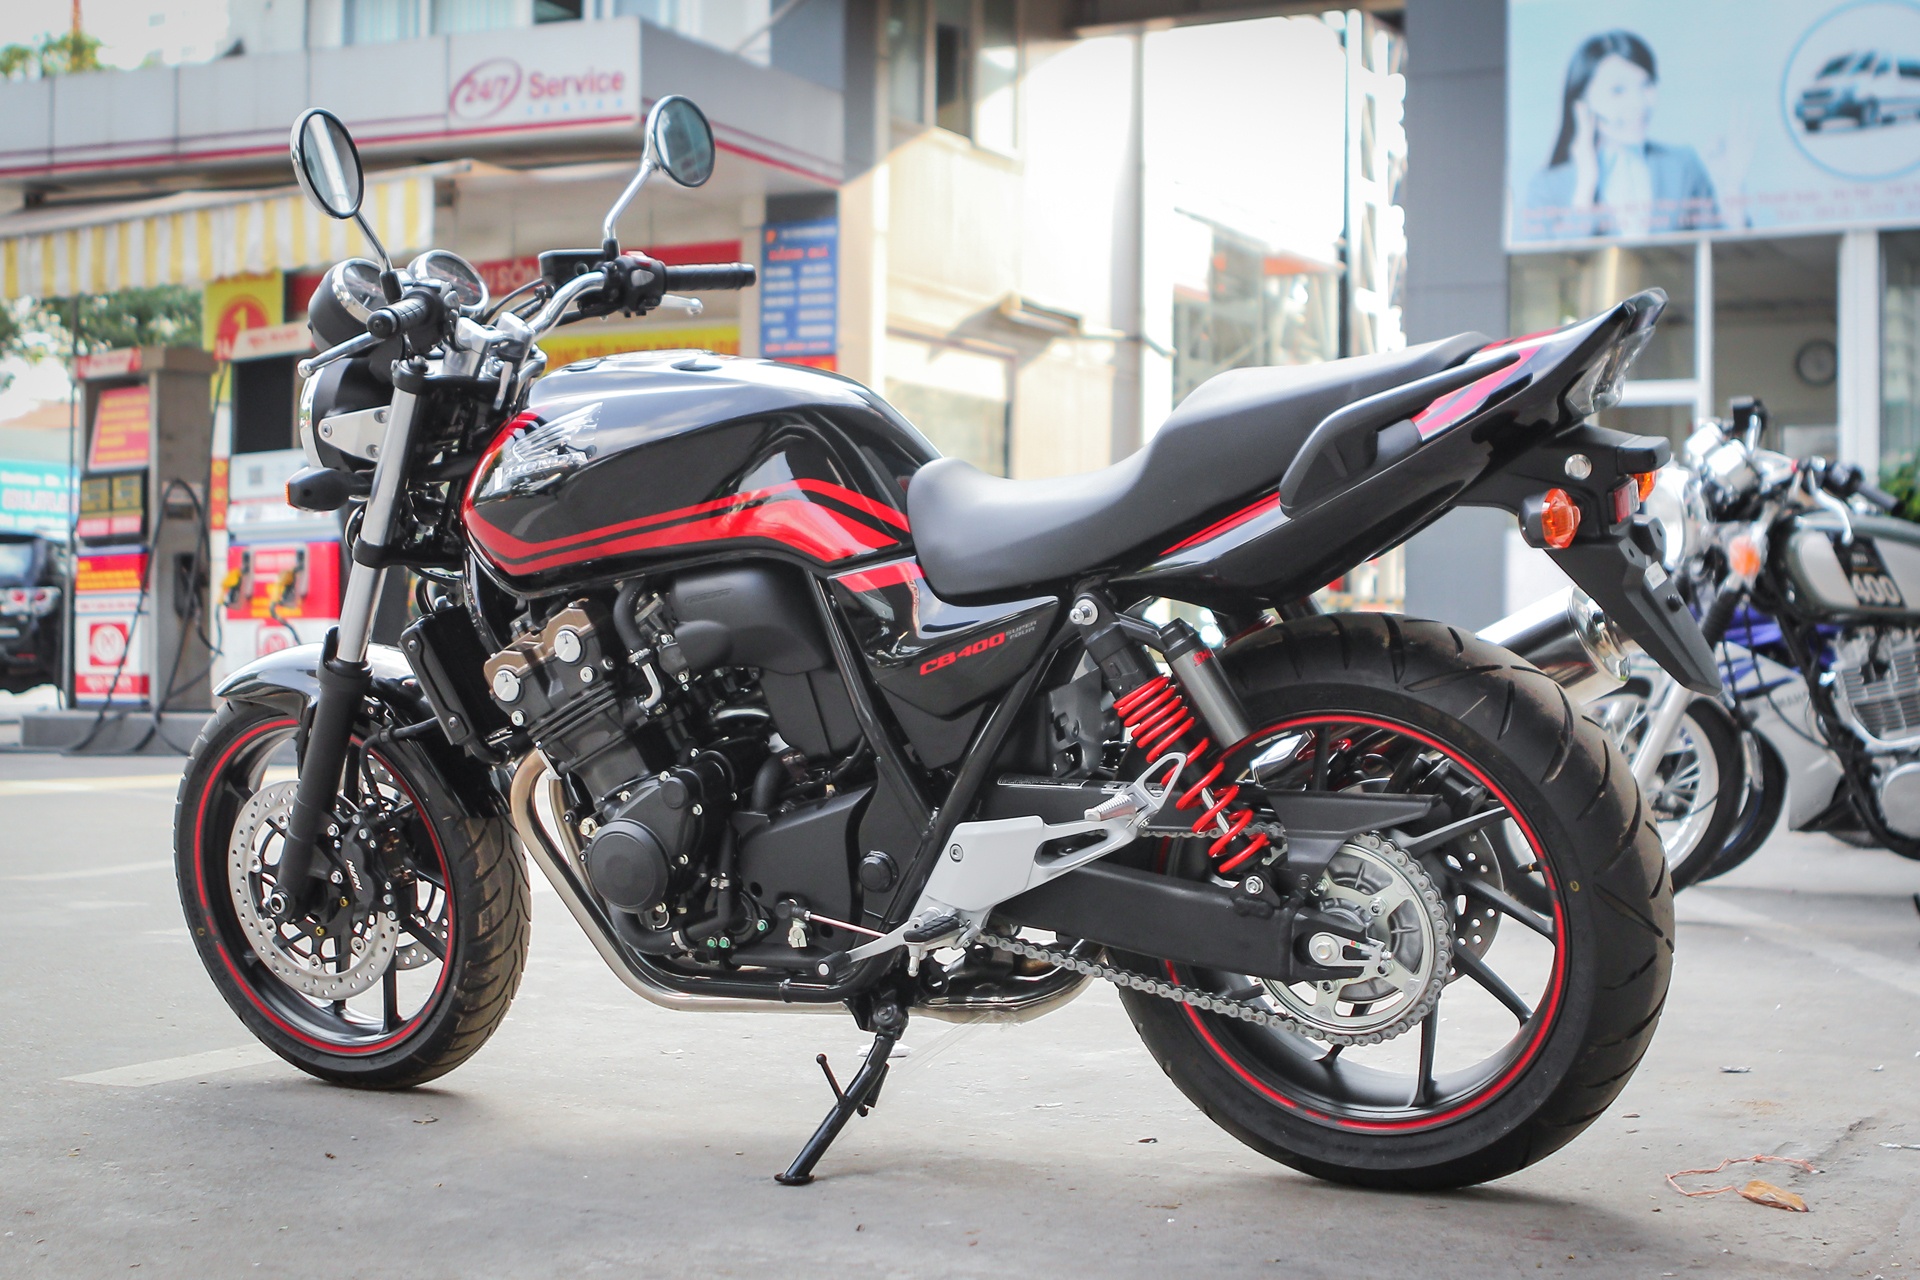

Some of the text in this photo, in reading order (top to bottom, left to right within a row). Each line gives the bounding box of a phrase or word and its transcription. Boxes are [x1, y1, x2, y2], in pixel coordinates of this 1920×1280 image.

[528, 66, 625, 99] Service
[506, 451, 588, 477] HONDA
[1851, 573, 1901, 603] 400
[1006, 620, 1037, 636] SUPER
[920, 631, 1006, 676] CB400
[346, 858, 363, 890] NISSIN
